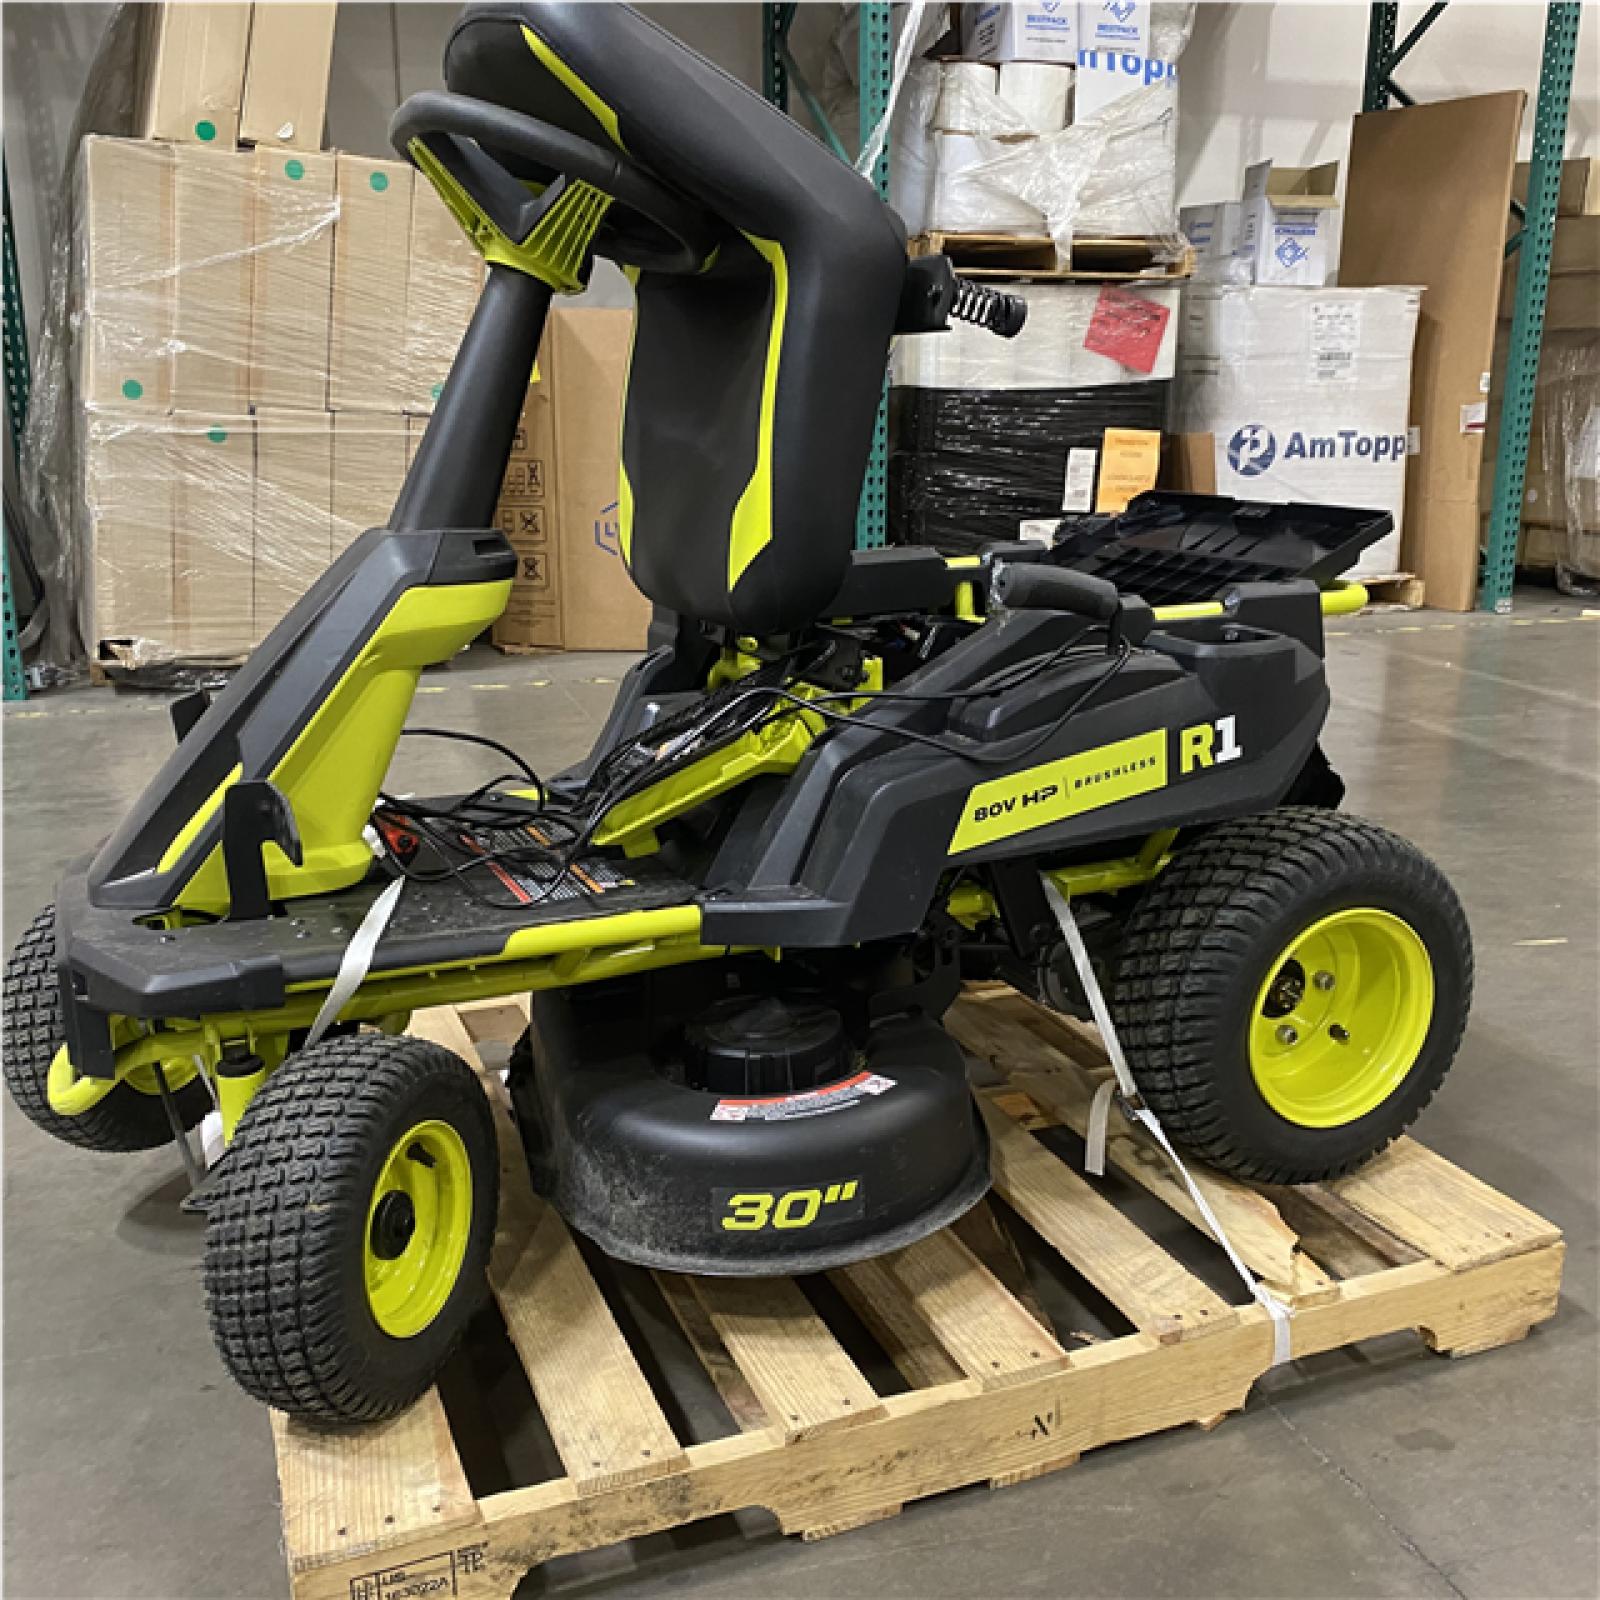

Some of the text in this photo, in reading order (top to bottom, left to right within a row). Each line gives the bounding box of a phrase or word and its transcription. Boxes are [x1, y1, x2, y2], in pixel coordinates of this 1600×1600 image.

[1284, 430, 1406, 463] AmTopp
[1179, 715, 1243, 775] R1
[1022, 784, 1059, 809] HP
[721, 1179, 859, 1231] 30"
